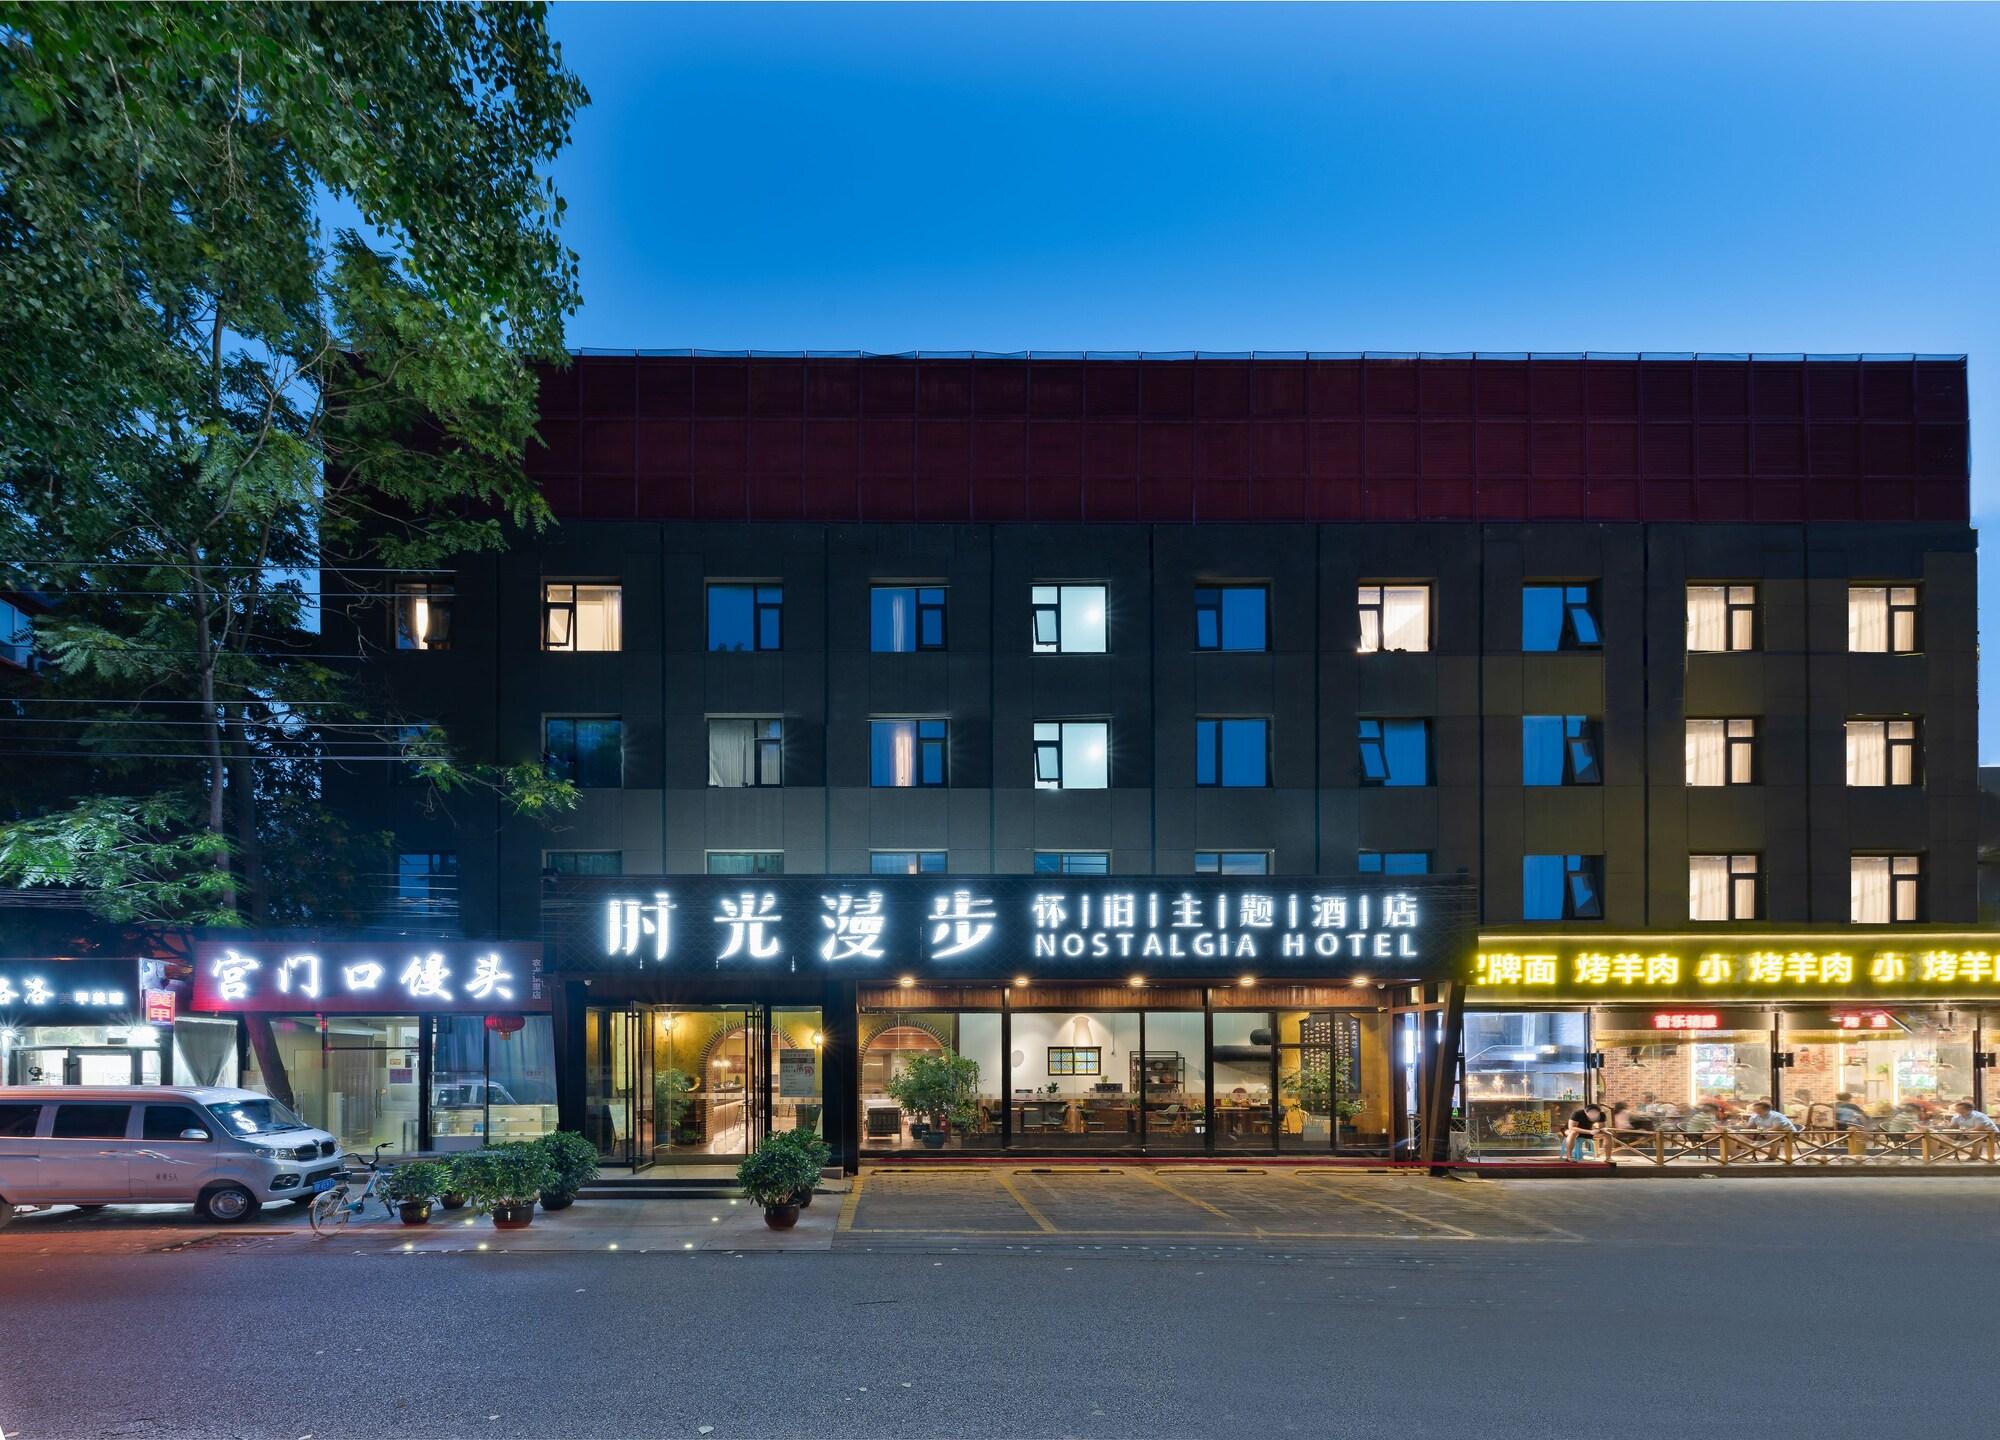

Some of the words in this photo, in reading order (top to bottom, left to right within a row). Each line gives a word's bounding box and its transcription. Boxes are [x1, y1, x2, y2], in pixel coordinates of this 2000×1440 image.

[606, 890, 997, 960] 时光漫步
[1035, 932, 1257, 957] NOSTALGIA
[1282, 932, 1418, 957] HOTEL
[210, 949, 513, 1002] 宫门口馒头
[1574, 951, 1680, 985] 烤羊肉
[1748, 950, 1854, 984] 烤羊肉
[1921, 949, 2000, 983] 烤羊
